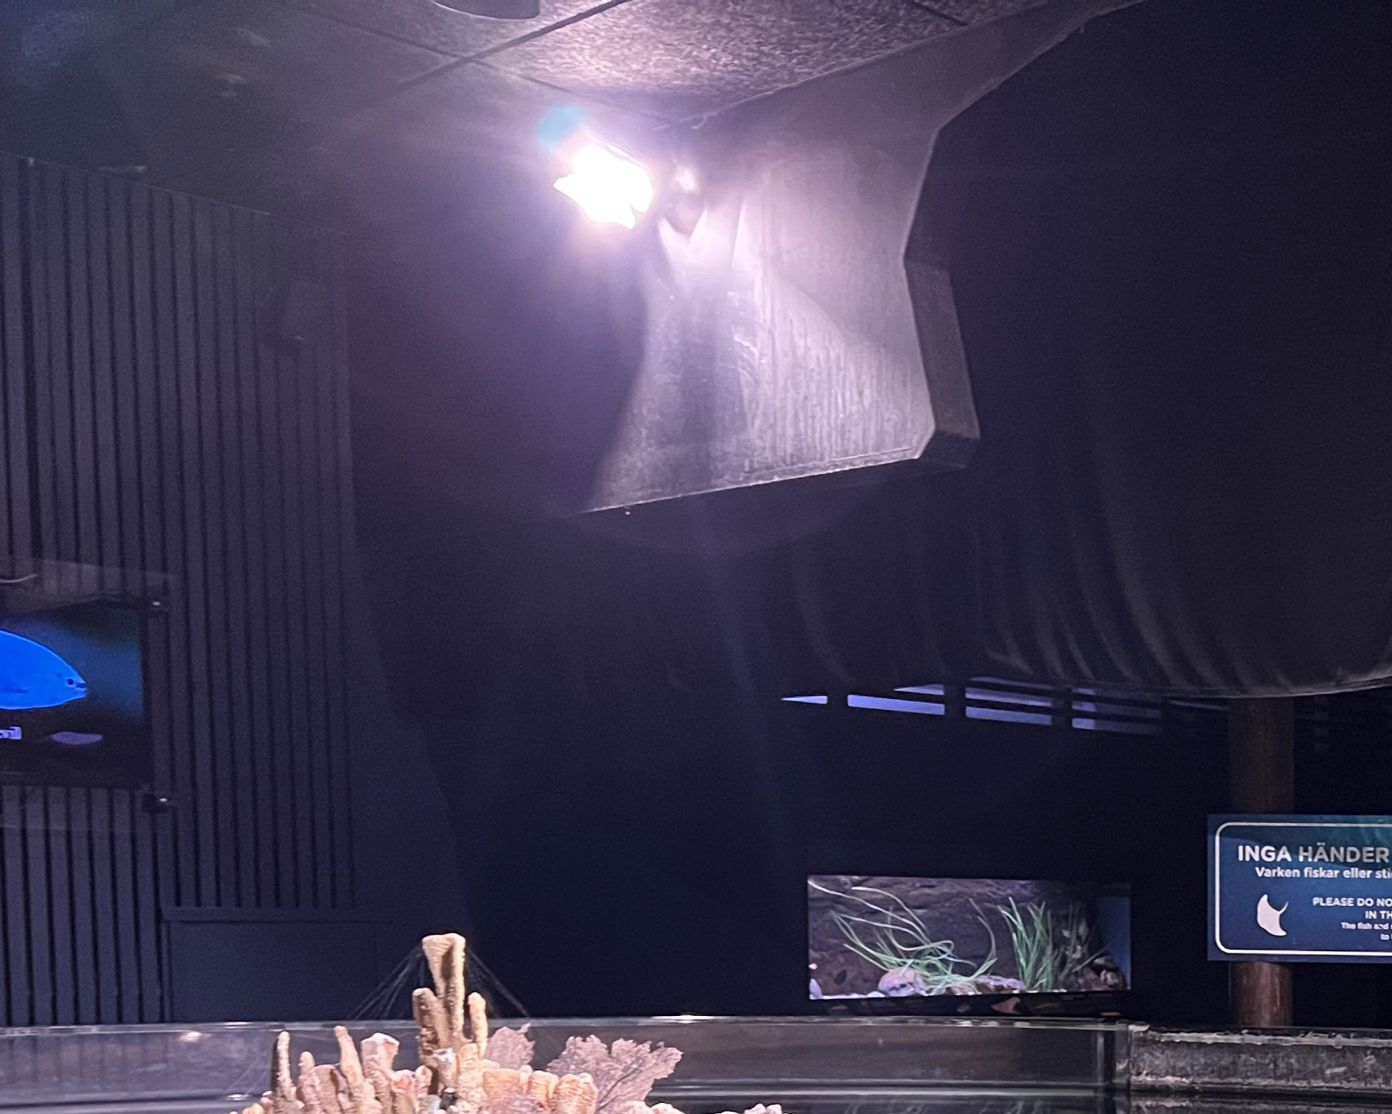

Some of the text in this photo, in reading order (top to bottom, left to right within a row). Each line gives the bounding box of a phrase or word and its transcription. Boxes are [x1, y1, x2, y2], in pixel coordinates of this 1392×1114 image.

[1238, 845, 1292, 862] INGA
[1298, 842, 1390, 863] HÄNDER
[1255, 866, 1301, 878] Varken
[1303, 866, 1339, 879] fiskar
[1342, 867, 1373, 879] eller
[1312, 897, 1354, 906] PLEASE
[1356, 898, 1375, 907] DO
[1365, 910, 1378, 919] IN
[1341, 922, 1356, 930] The
[1357, 922, 1372, 930] fish
